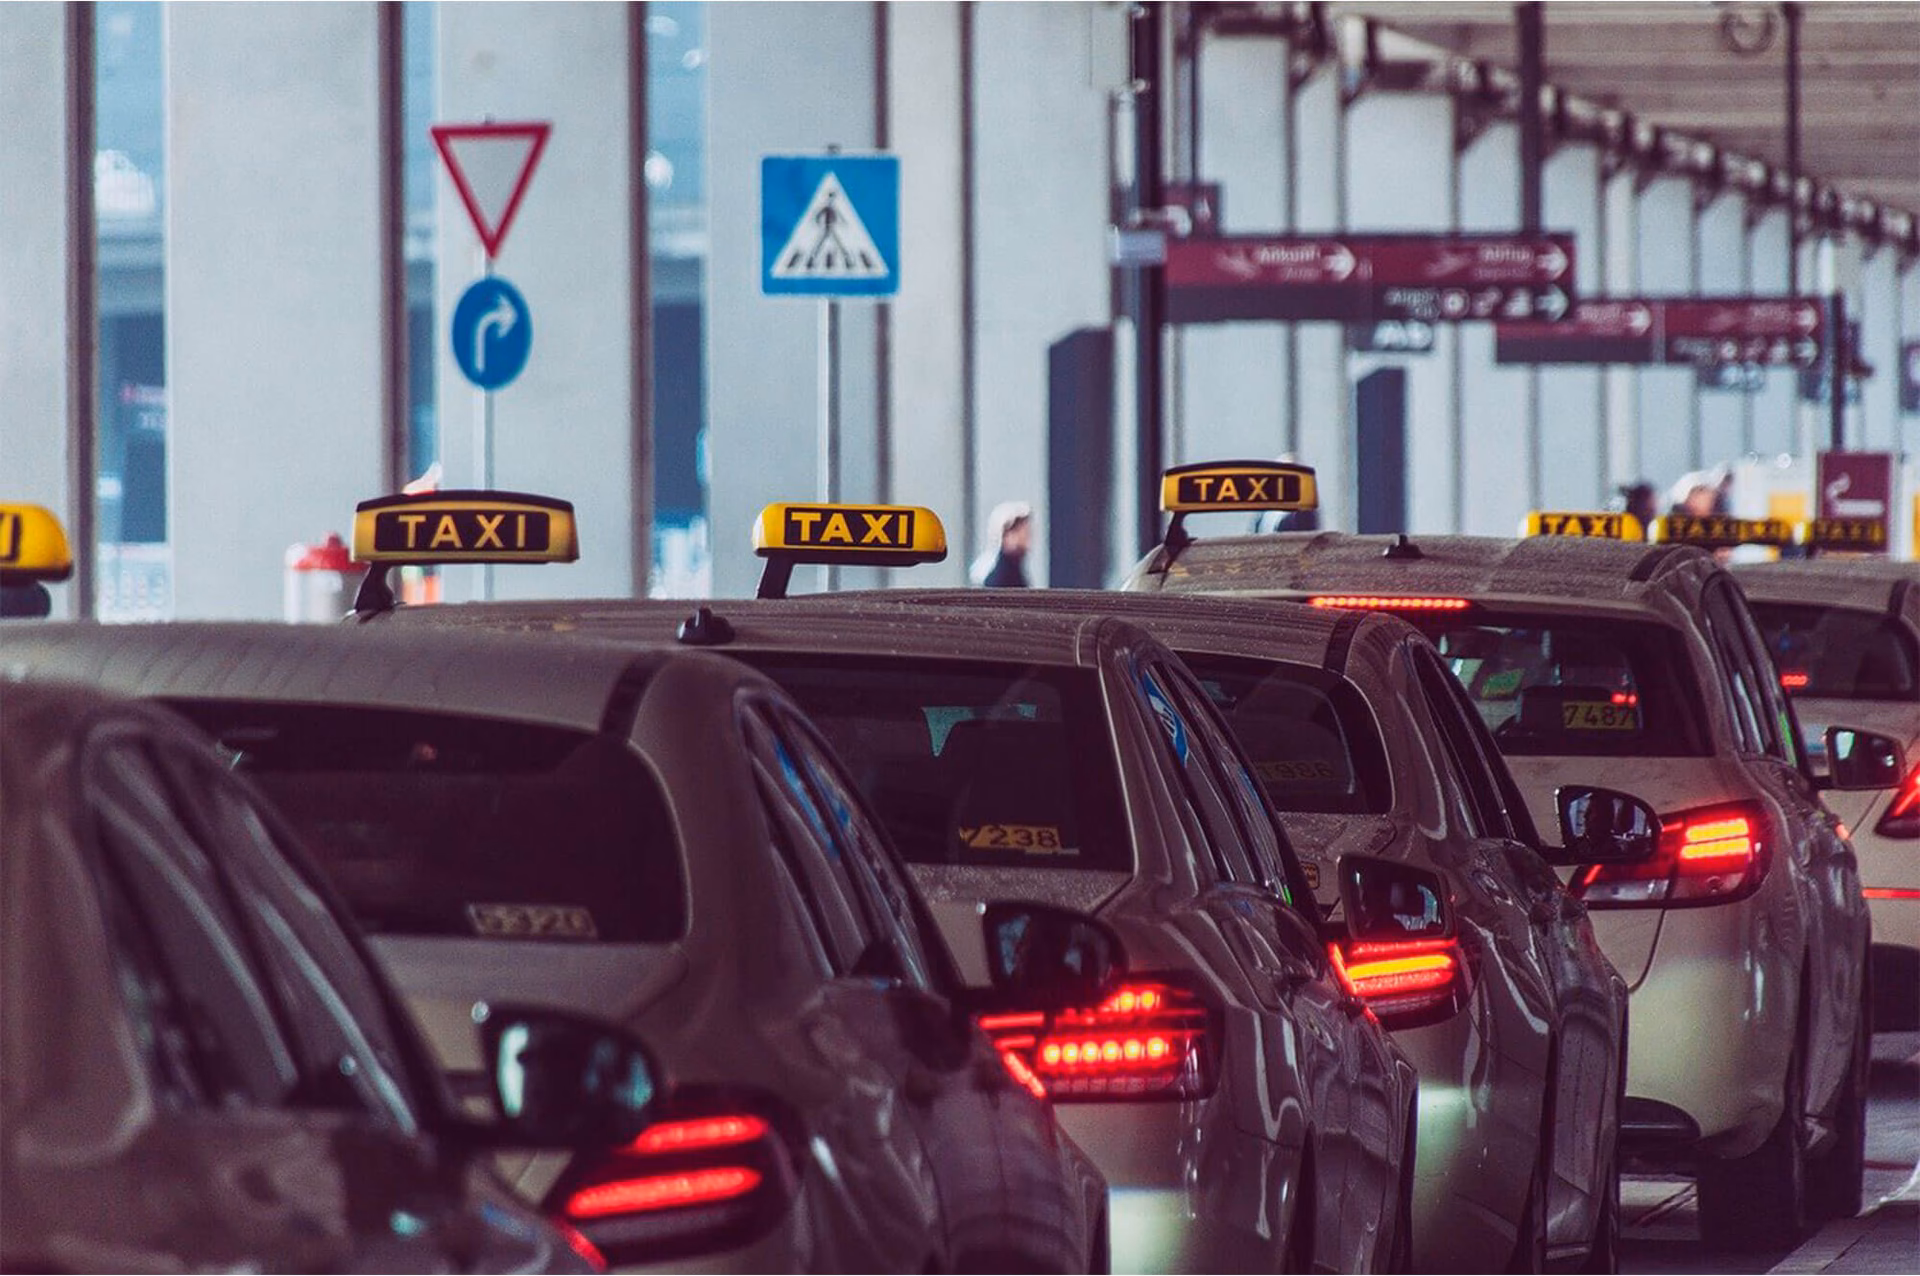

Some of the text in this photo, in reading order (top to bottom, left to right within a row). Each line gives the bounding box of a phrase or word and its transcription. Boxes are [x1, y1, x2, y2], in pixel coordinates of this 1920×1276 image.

[1193, 477, 1285, 502] TAXI
[398, 514, 526, 549] TAXI
[791, 511, 909, 546] TAXI
[1542, 514, 1621, 537] TAXI
[1564, 704, 1628, 727] 7487
